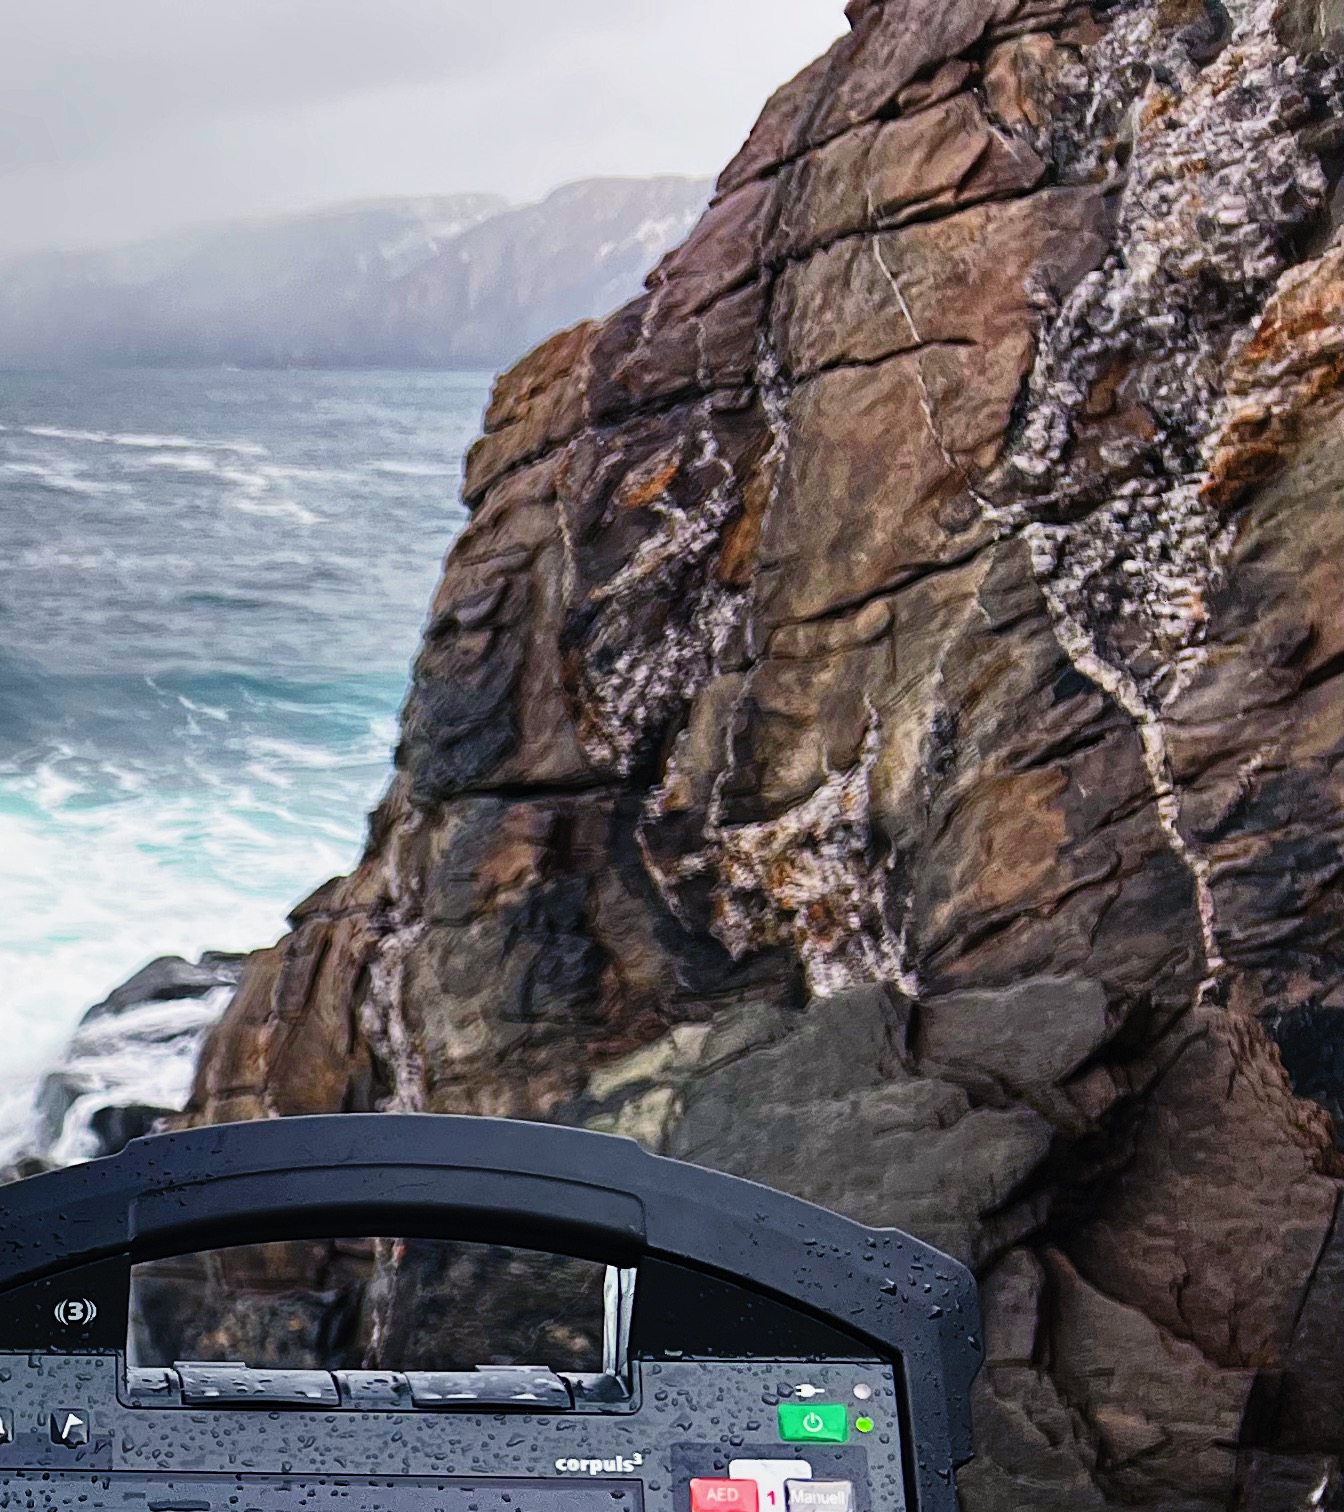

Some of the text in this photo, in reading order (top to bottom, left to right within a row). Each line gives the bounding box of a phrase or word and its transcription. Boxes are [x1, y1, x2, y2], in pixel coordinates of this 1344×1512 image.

[706, 1487, 845, 1506] AED 1 Manuell
